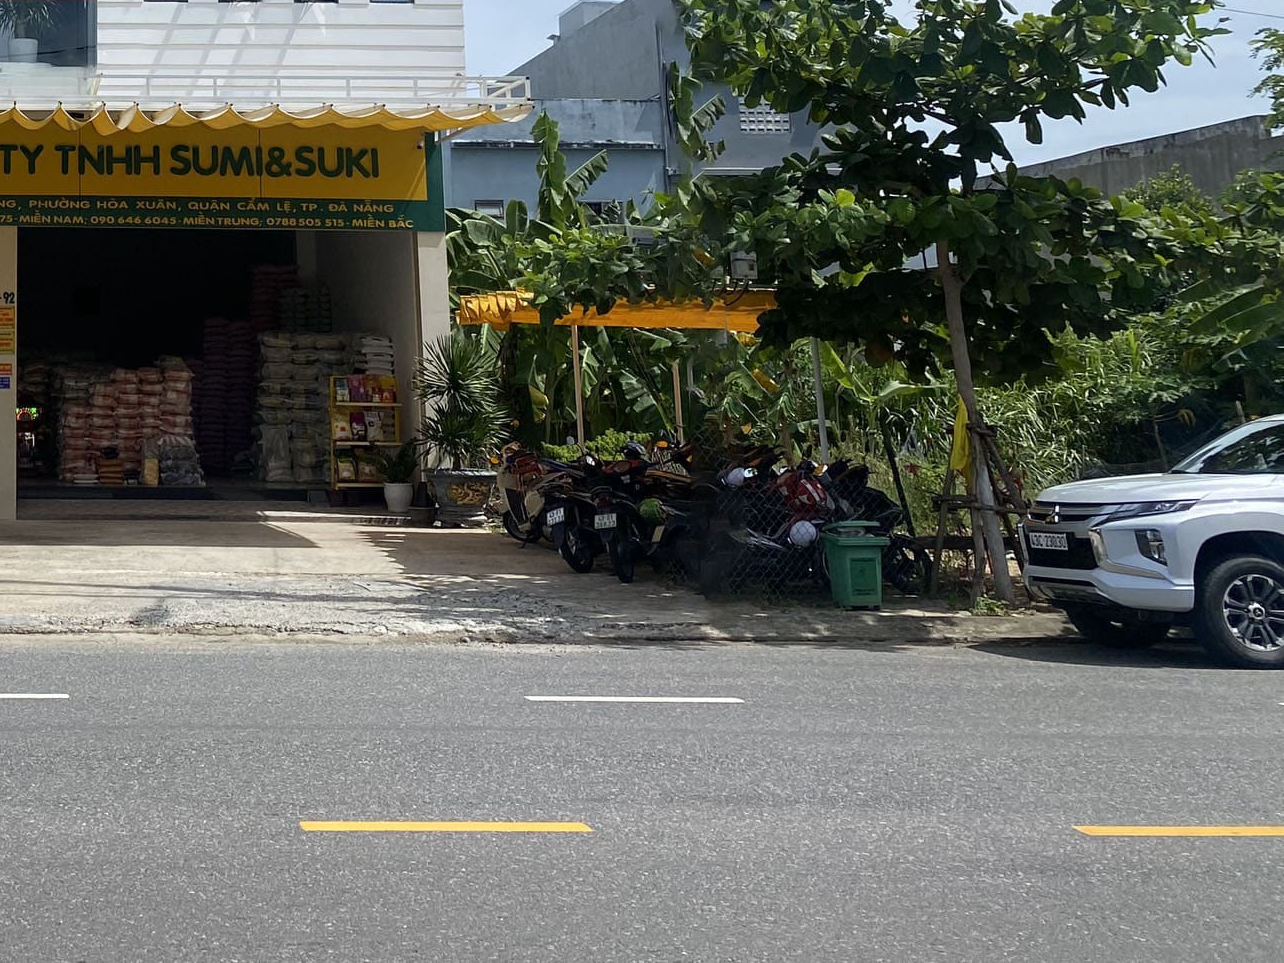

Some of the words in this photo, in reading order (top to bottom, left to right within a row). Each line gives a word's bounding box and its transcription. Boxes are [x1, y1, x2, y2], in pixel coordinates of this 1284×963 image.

[55, 144, 161, 176] TNHH
[170, 144, 380, 179] SUMI&SUKI
[29, 196, 91, 210] PHƯỜNG
[96, 197, 129, 210] HÒA
[188, 199, 230, 213] QUẬN
[328, 201, 349, 213] ĐÀ
[353, 199, 395, 213] NẴNG
[90, 215, 115, 225] 090
[117, 215, 142, 225] 646
[266, 217, 296, 227] 0788
[298, 218, 321, 227] 505
[388, 214, 414, 229] BẮC
